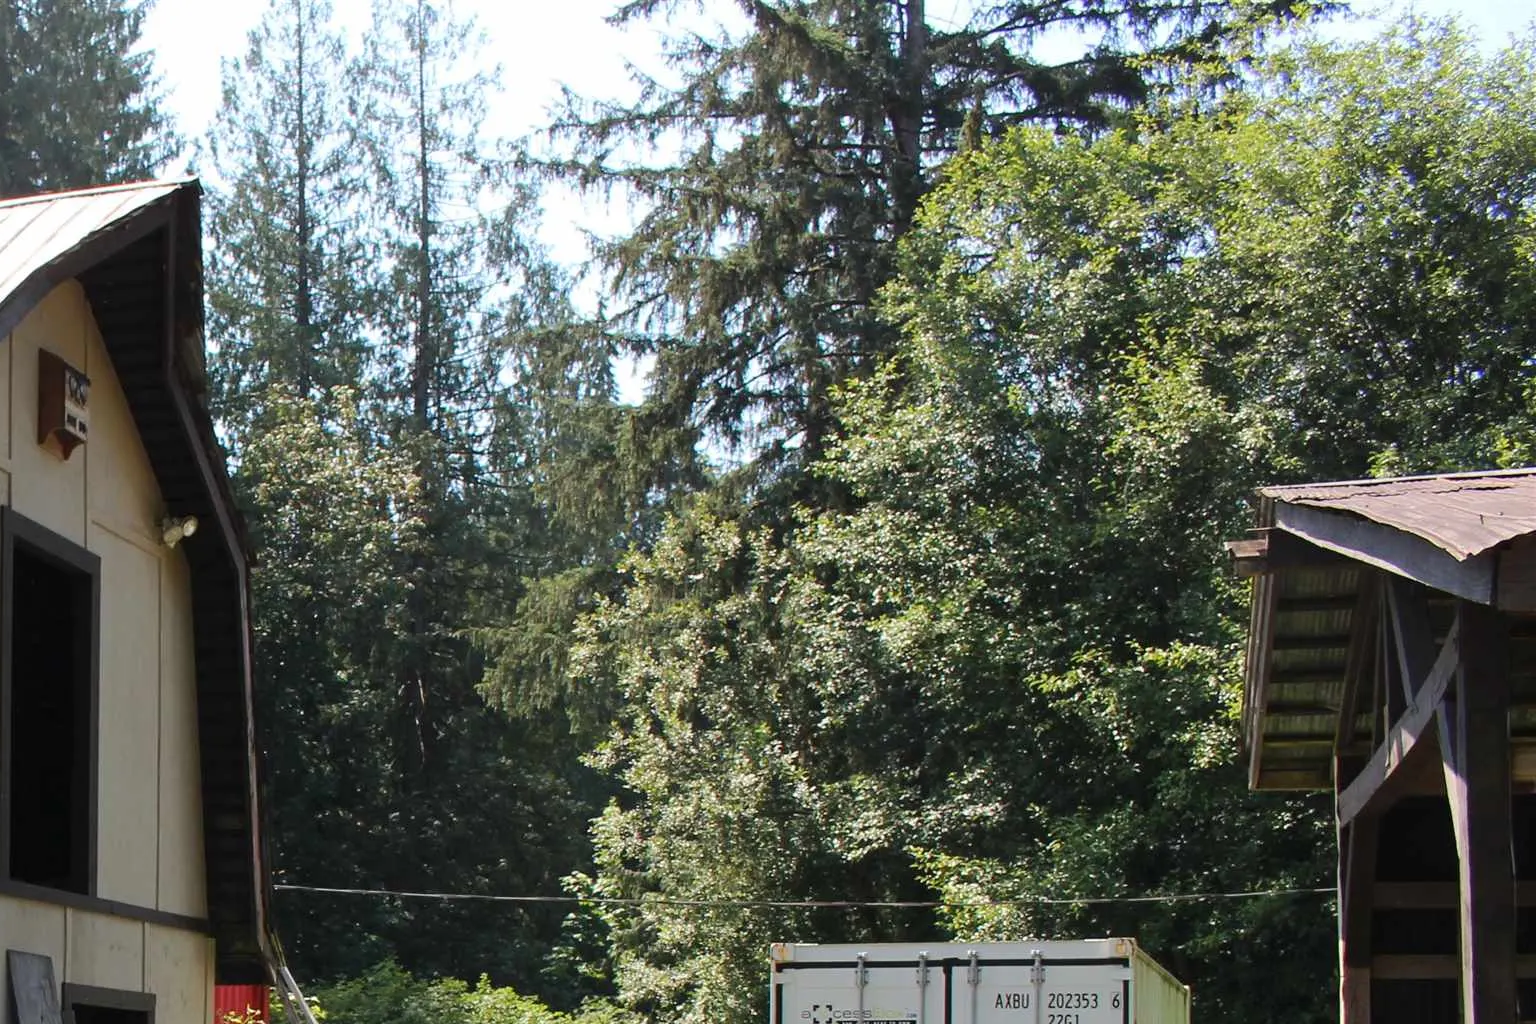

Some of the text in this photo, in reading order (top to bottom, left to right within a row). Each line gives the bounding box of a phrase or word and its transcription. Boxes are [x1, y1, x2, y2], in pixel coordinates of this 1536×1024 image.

[994, 993, 1121, 1009] AXBU 202353 6
